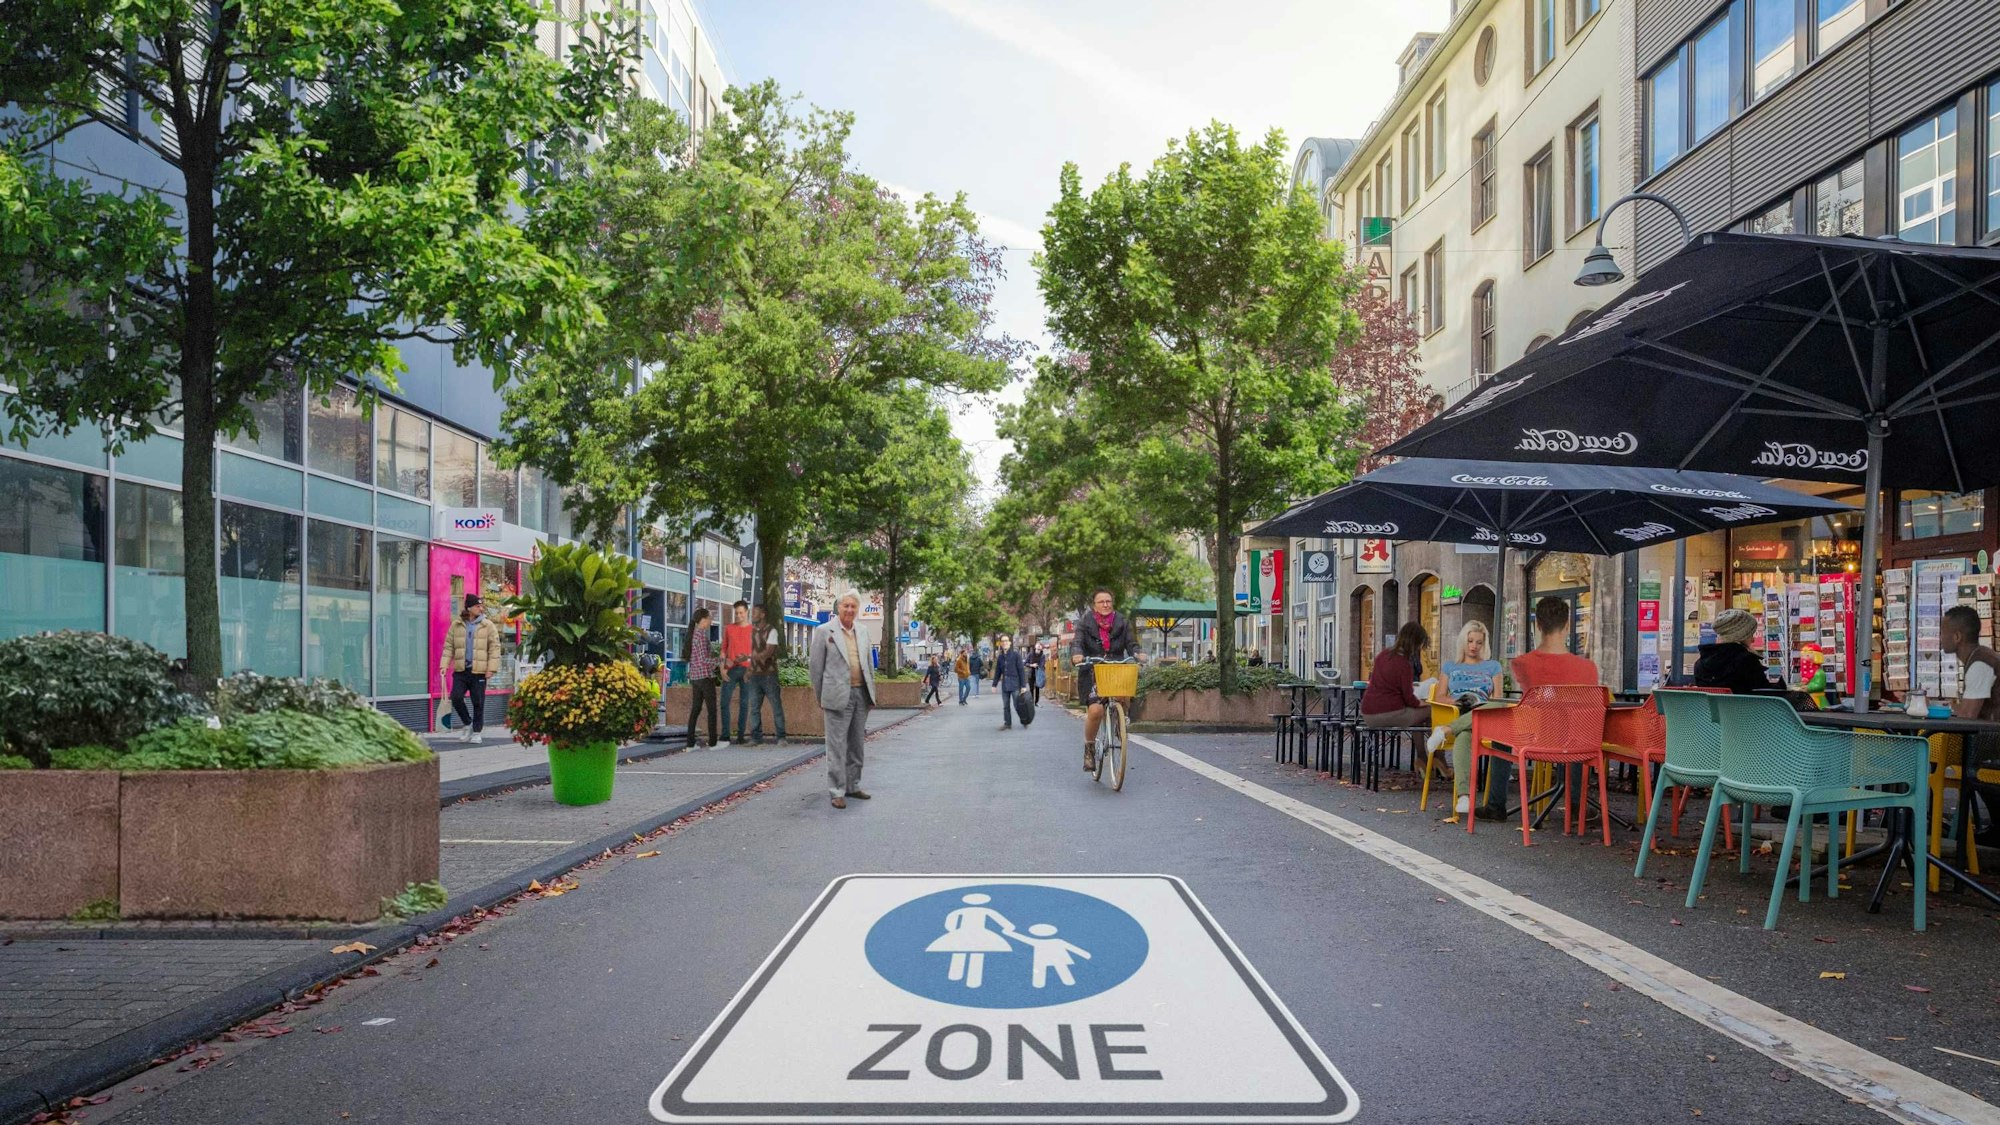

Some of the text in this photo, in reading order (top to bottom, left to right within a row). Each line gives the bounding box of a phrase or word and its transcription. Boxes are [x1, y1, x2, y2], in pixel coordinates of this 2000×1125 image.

[1451, 473, 1553, 486] Coca-Cola
[1650, 483, 1751, 499] Coca-Cola
[847, 1024, 1163, 1080] ZONE
